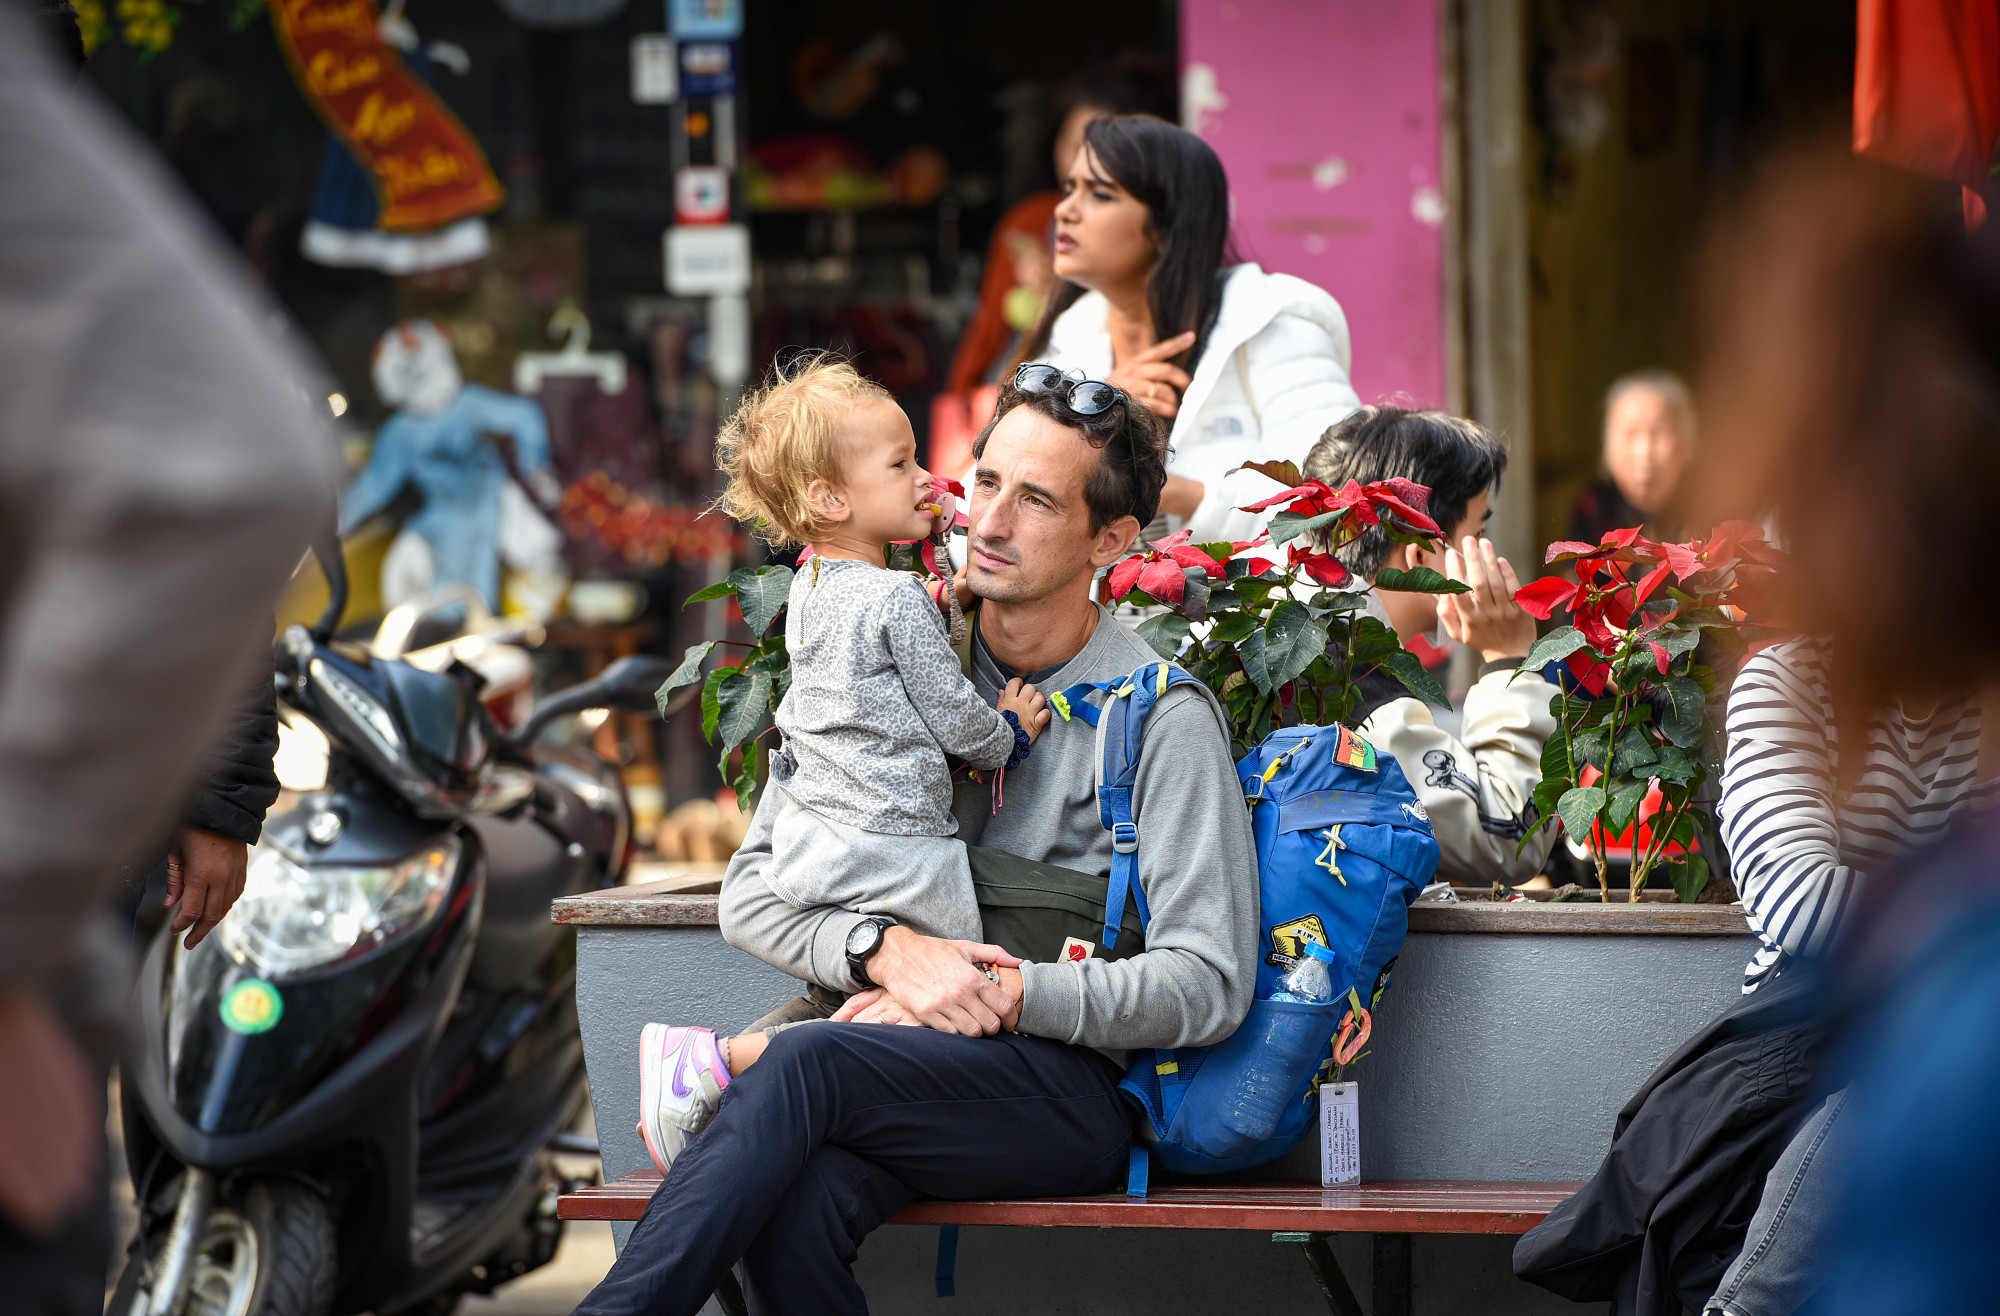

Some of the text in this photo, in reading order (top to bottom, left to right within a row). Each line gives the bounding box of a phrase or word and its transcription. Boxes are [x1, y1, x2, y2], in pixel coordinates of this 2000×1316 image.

[1301, 922, 1320, 934] ZEALAND
[1297, 929, 1317, 942] KIWI
[1273, 954, 1290, 963] NEXT
